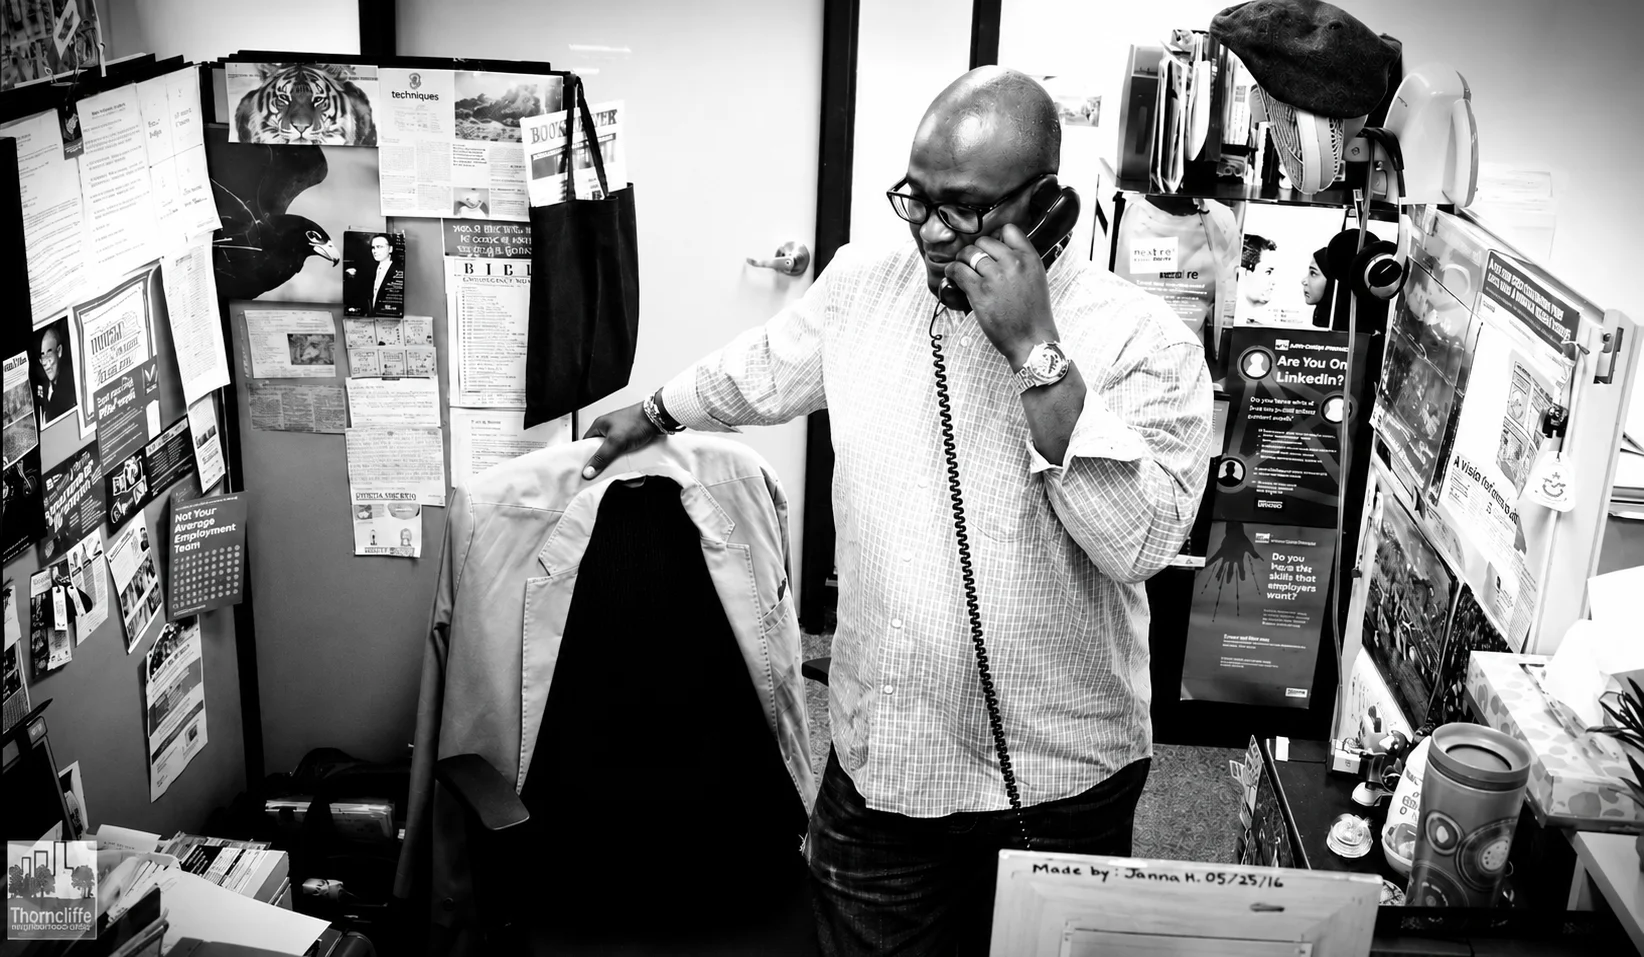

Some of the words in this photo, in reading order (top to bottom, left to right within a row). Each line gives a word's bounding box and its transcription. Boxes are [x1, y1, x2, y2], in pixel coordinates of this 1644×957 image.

[391, 90, 439, 101] techniques
[1277, 356, 1300, 367] Are
[1303, 356, 1326, 369] You
[1329, 358, 1347, 370] On
[1276, 371, 1344, 386] LinkedIn?
[175, 511, 192, 523] Not
[194, 507, 217, 518] Your
[174, 523, 236, 543] Employment
[174, 541, 200, 554] Team
[1272, 552, 1286, 561] Do
[1287, 555, 1305, 564] you
[1269, 571, 1293, 581] skills
[1295, 574, 1316, 583] that
[1267, 582, 1317, 593] employers
[1266, 592, 1297, 600] want?
[1032, 863, 1082, 875] Made
[1124, 867, 1180, 883] Janna
[1185, 873, 1201, 884] H.
[1205, 872, 1284, 889] 05/25/16
